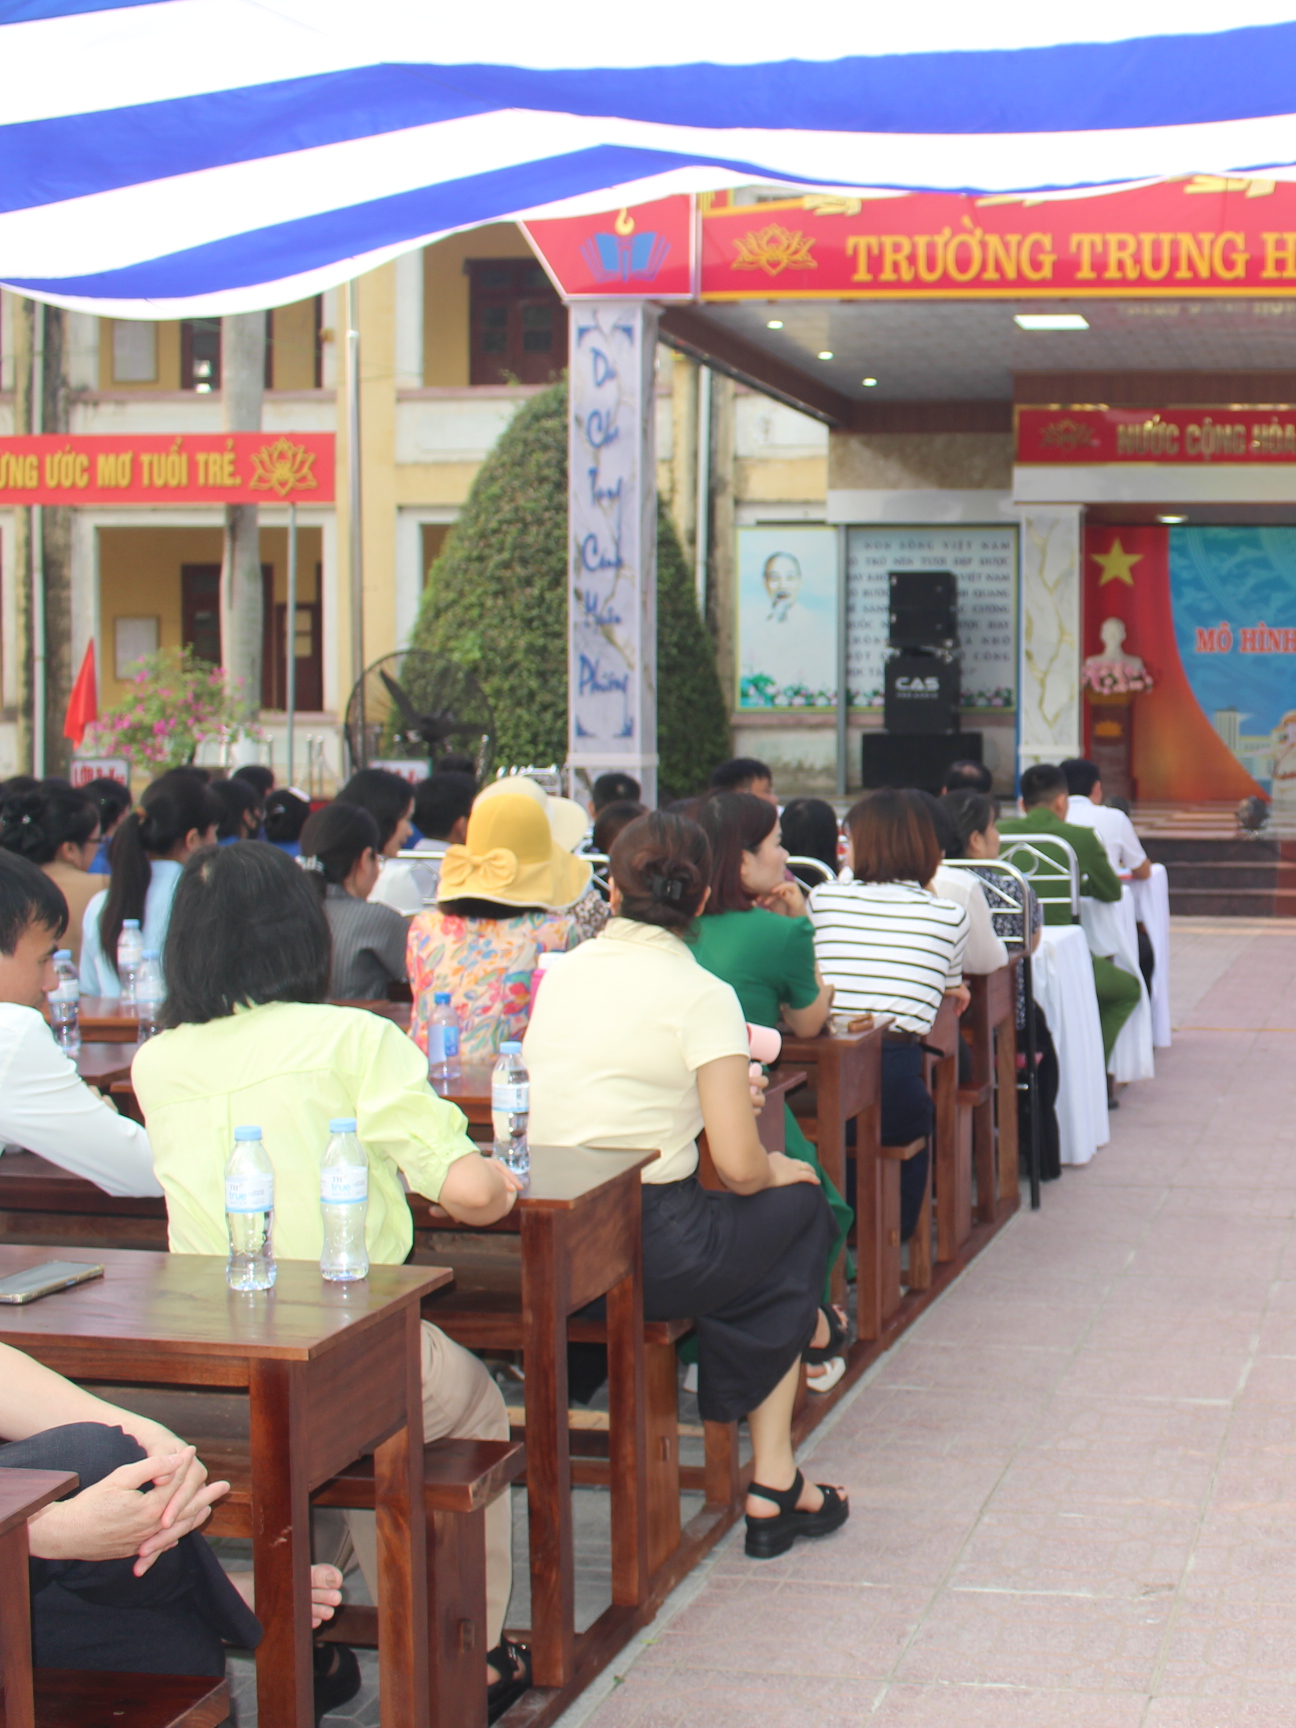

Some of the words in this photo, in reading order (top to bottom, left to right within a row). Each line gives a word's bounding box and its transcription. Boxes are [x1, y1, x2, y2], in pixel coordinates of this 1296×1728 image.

[847, 214, 1057, 282] TRƯỜNG
[1069, 231, 1249, 281] TRUNG
[1117, 414, 1180, 454] NƯỚC
[1185, 417, 1246, 461] CỘNG
[45, 444, 90, 489] ƯỚC
[97, 451, 133, 489] MƠ
[140, 436, 188, 488] TUỔI
[196, 438, 242, 488] TRẺ.
[1195, 621, 1234, 653] MÔ
[895, 677, 940, 691] CAS
